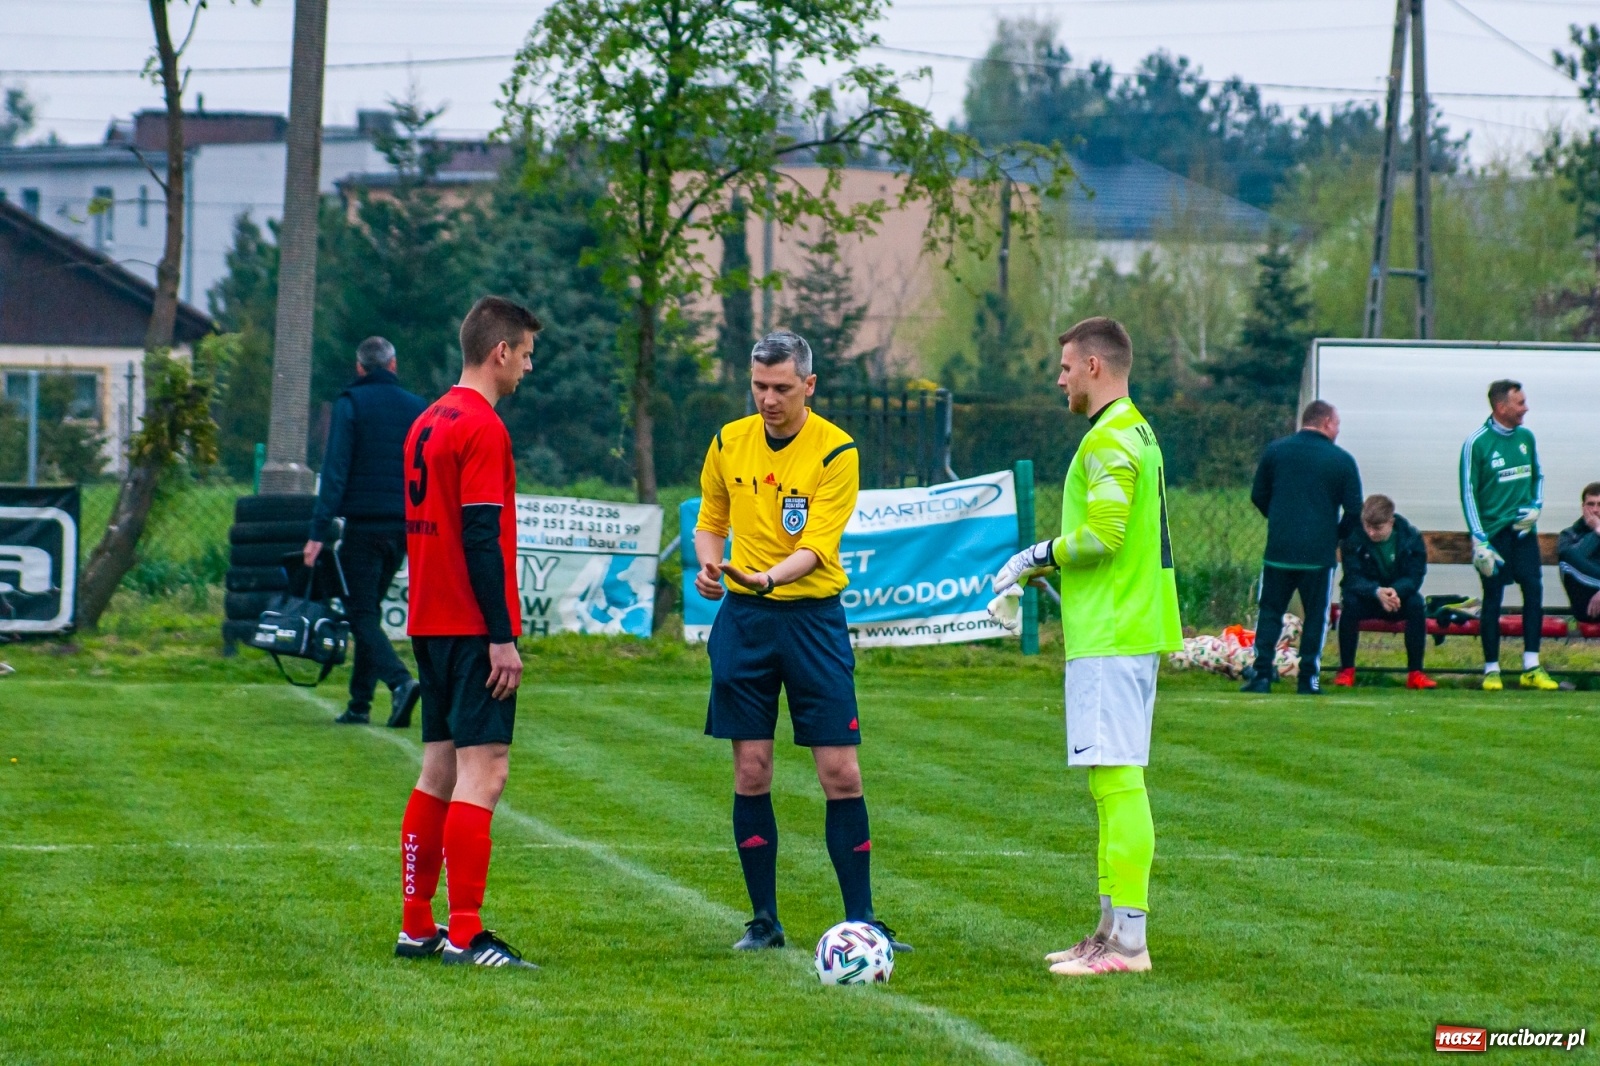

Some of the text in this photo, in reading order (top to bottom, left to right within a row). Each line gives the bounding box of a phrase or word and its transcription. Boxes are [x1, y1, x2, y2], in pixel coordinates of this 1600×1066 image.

[408, 426, 433, 508] 5
[517, 501, 620, 519] +48 607 543 236
[858, 494, 980, 522] MARTCOM
[517, 516, 641, 535] +49 151 21 31 81 99
[517, 531, 638, 550] w.lundmbau.eu
[840, 549, 876, 574] ET
